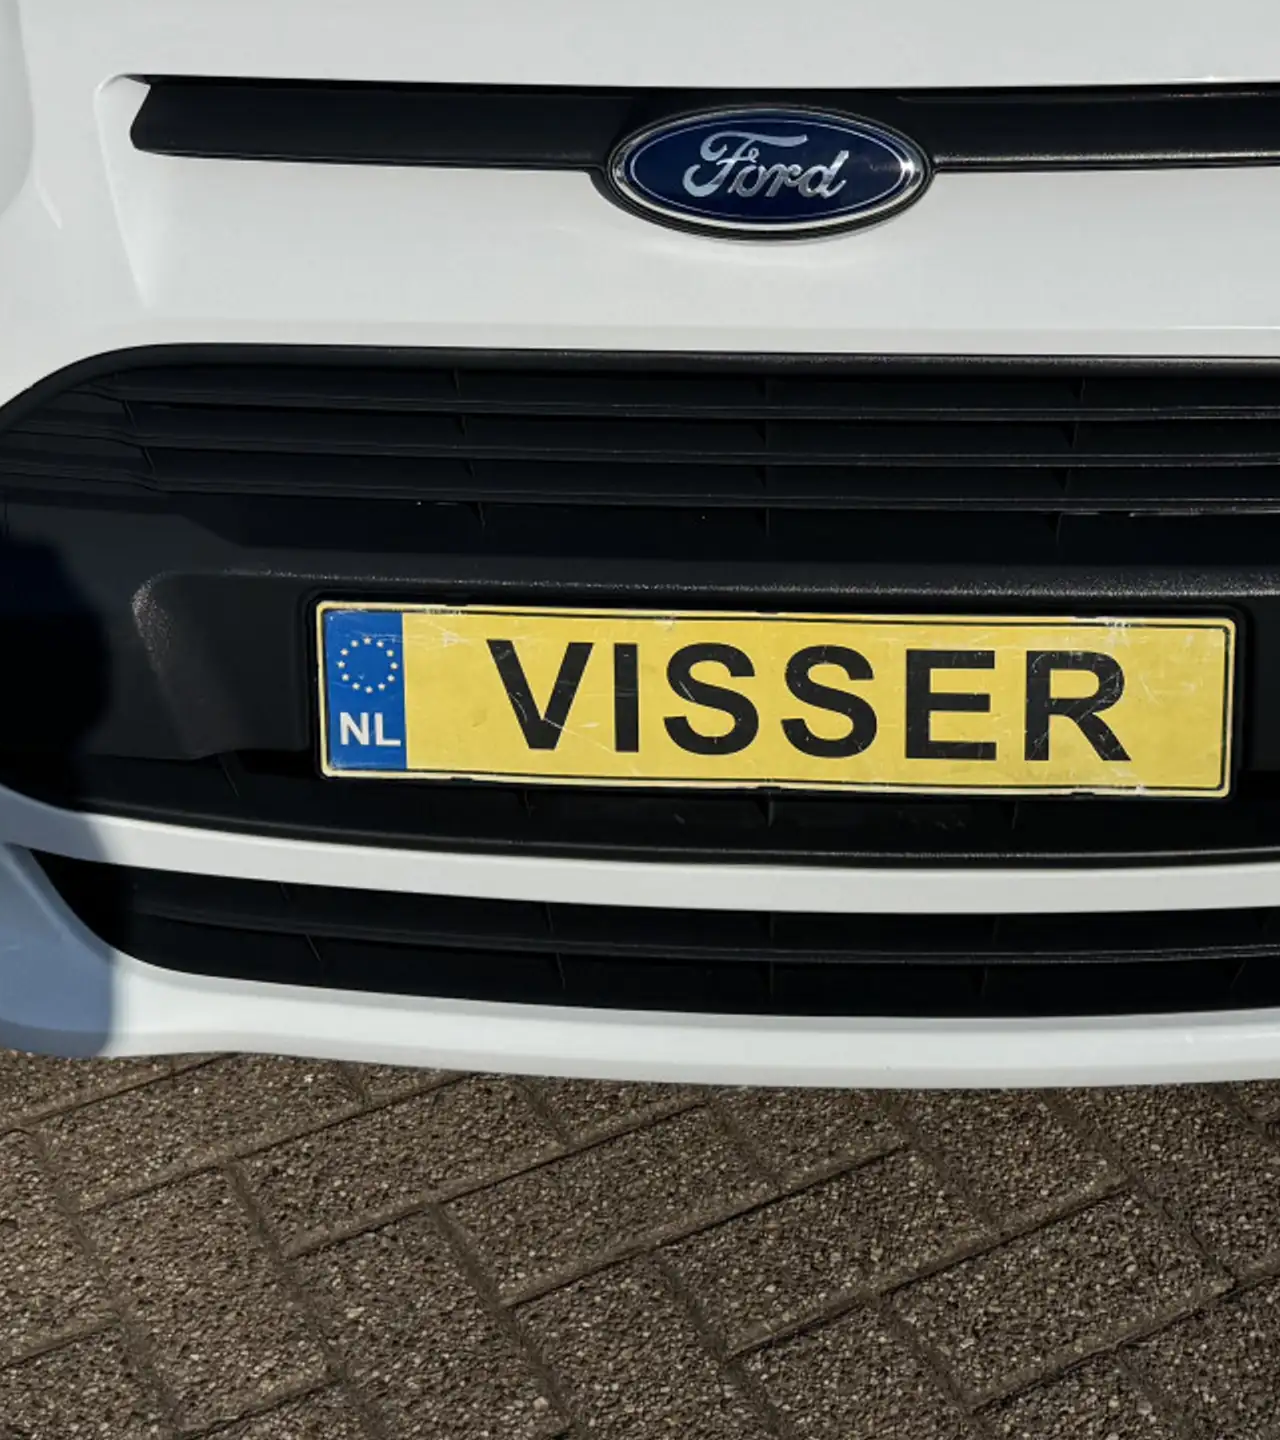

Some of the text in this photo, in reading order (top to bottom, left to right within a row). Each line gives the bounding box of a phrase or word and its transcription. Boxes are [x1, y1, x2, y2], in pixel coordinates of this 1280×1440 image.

[681, 130, 850, 199] Ford
[339, 639, 1132, 765] NL VISSER
